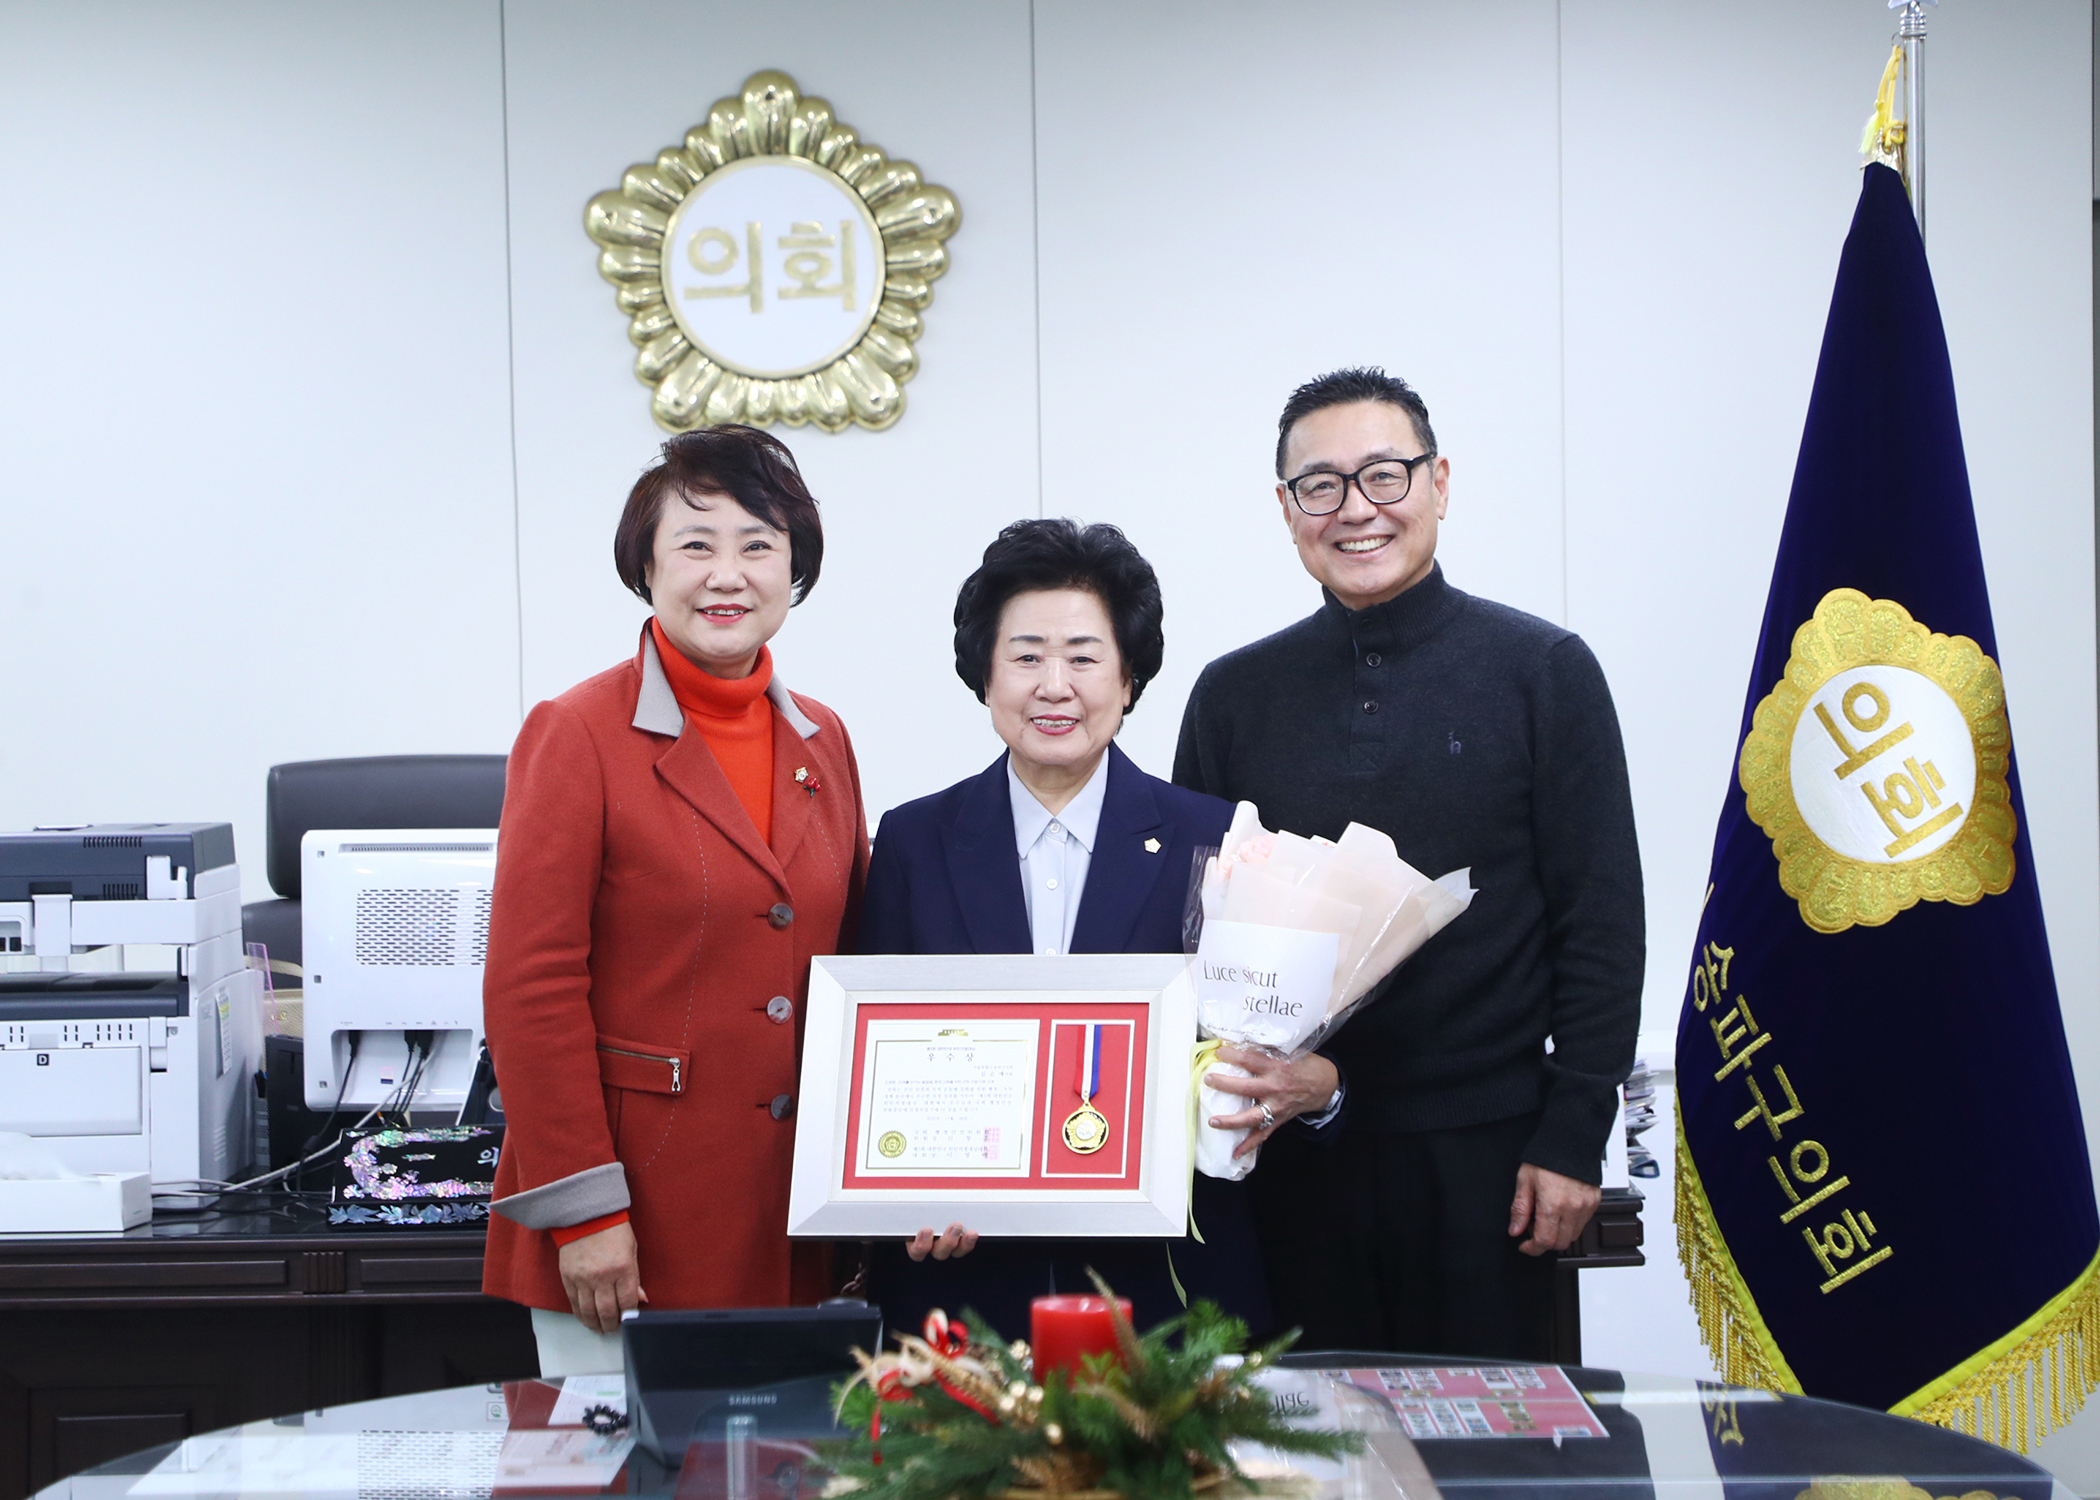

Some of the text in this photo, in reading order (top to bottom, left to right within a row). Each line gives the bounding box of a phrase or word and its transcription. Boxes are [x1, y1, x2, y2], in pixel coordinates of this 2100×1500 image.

[684, 219, 857, 314] 의회
[1813, 682, 1964, 858] 의회
[1203, 960, 1278, 989] Luce sicut
[1243, 995, 1303, 1018] stellae
[1694, 940, 1894, 1295] 송파구의회
[729, 1394, 777, 1406] SAMSUNG
